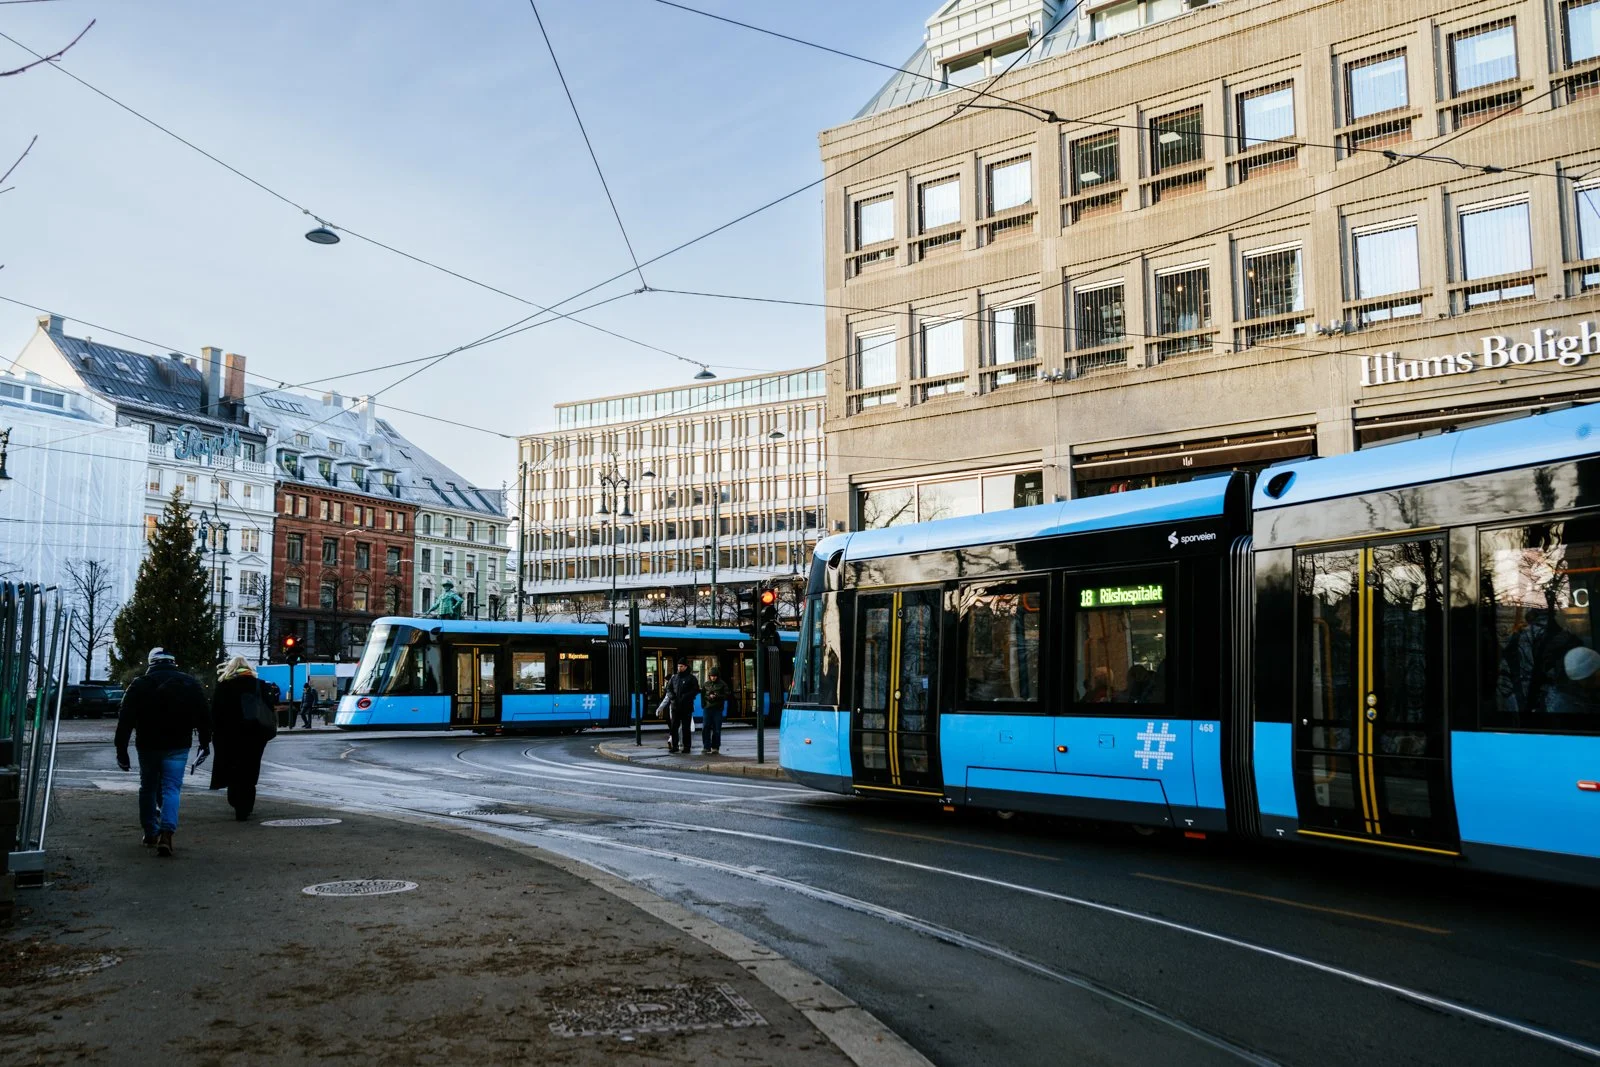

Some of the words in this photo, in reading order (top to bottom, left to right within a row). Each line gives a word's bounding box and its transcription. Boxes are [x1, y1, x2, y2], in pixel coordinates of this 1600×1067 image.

[1360, 350, 1474, 387] Illums
[1180, 531, 1217, 545] sporveien
[1080, 589, 1094, 607] 18
[1100, 584, 1163, 606] Rikshospitalet
[1198, 723, 1215, 734] 468
